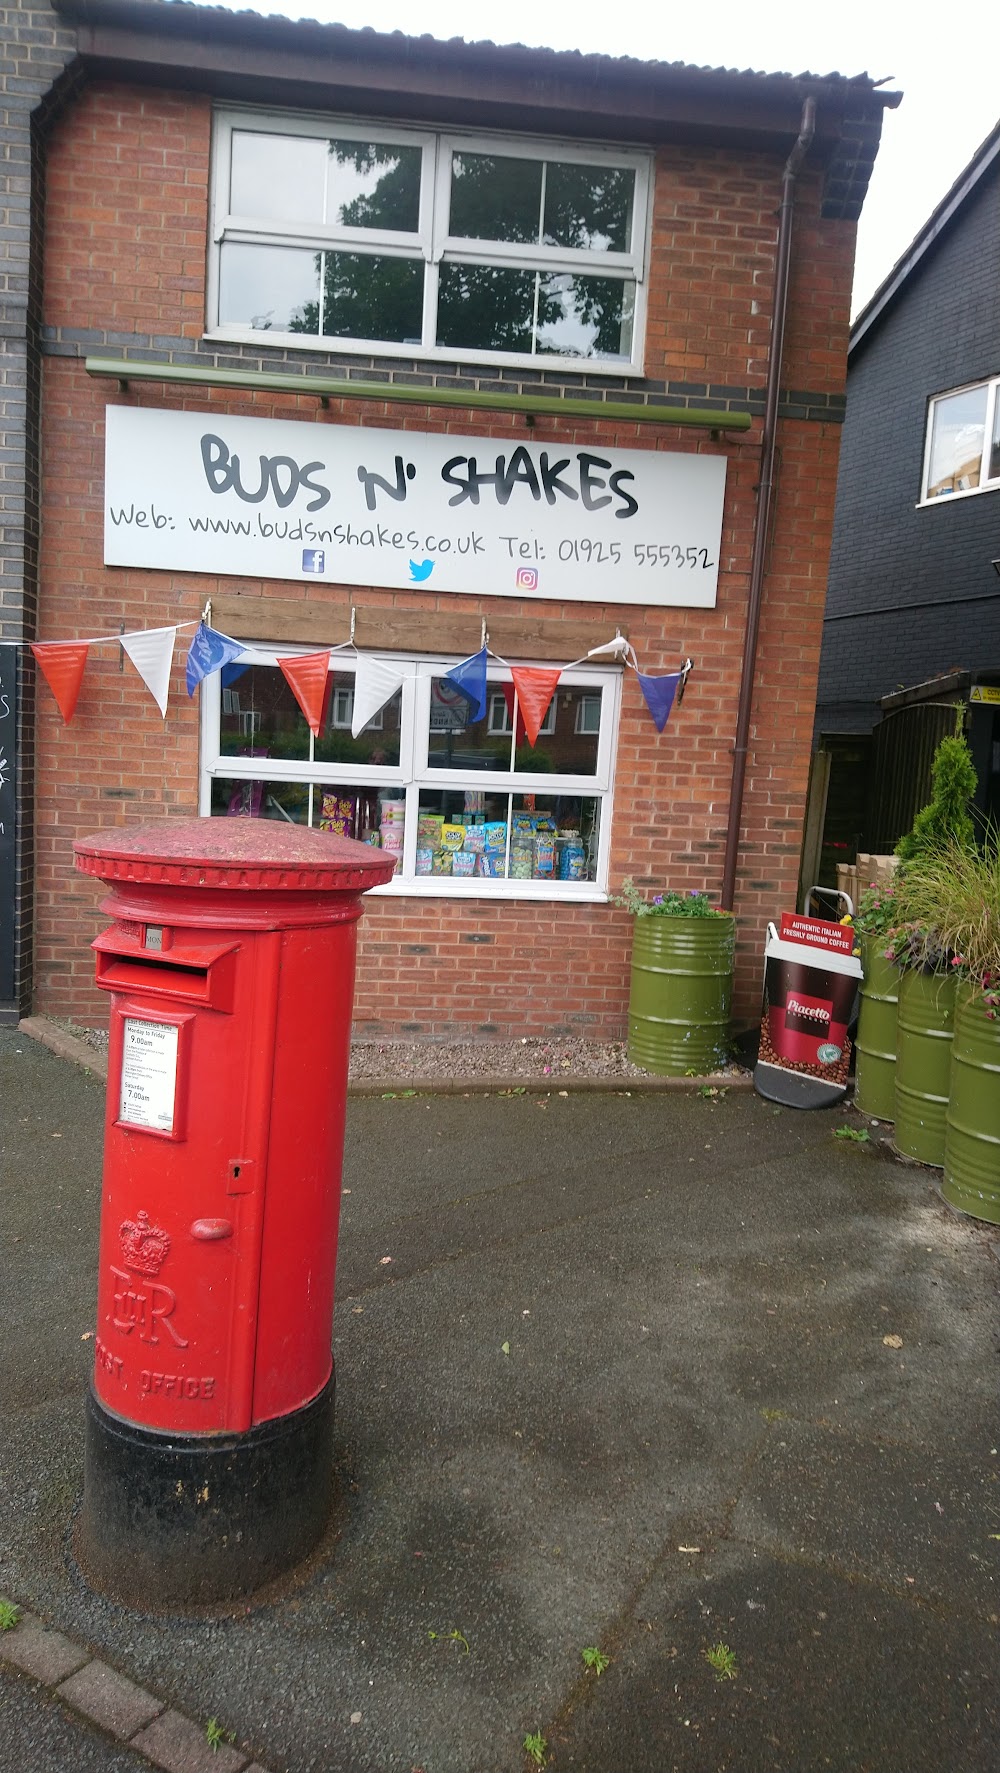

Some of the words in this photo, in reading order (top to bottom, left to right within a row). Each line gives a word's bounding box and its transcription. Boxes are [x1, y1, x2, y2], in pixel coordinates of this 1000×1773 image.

[200, 433, 331, 512] BUDS
[441, 446, 639, 519] SHAKES
[110, 503, 176, 530] Web:
[189, 512, 486, 555] www.budsnshakes.co.uk
[499, 536, 546, 560] Tel:
[558, 538, 622, 564] 01925
[634, 543, 715, 569] 555352
[792, 921, 820, 933] AUTHENTIC
[821, 928, 842, 938] ITALIAN
[147, 936, 162, 944] MON
[783, 928, 805, 939] FRESHLY
[806, 933, 828, 944] GROUND
[829, 939, 849, 949] COFFEE
[787, 999, 830, 1020] Piacetto
[139, 1020, 160, 1029] Collection
[127, 1027, 145, 1036] Monday
[151, 1031, 166, 1039] Friday
[131, 1035, 153, 1046] 9.00am
[125, 1081, 144, 1091] Saturday
[128, 1090, 150, 1101] 7.00am
[141, 1369, 216, 1400] OFFICE
